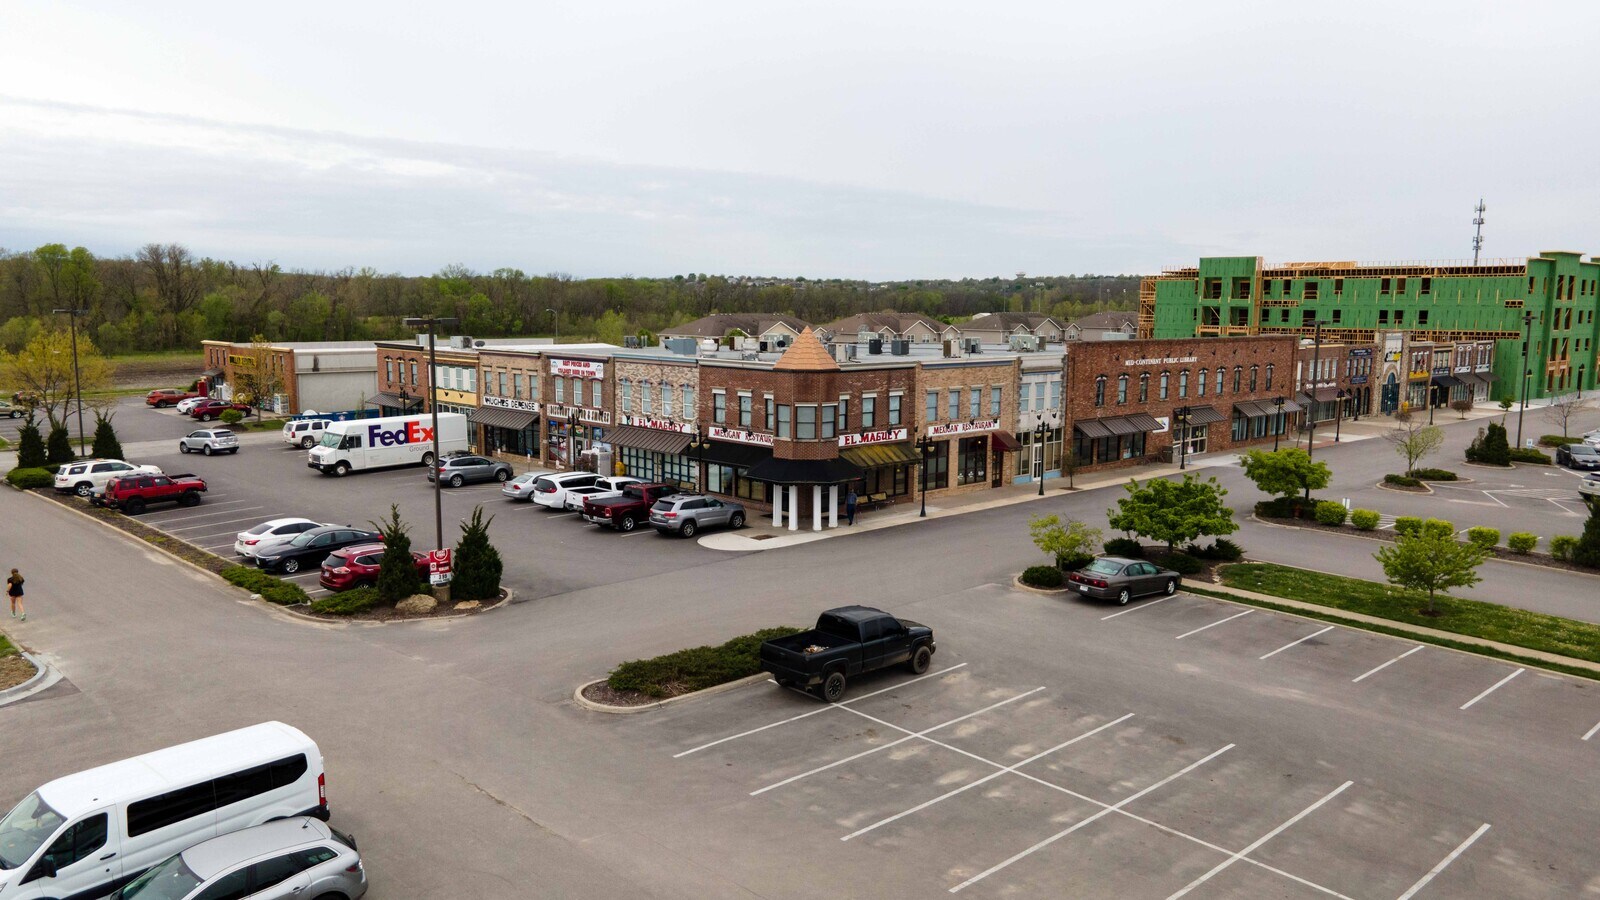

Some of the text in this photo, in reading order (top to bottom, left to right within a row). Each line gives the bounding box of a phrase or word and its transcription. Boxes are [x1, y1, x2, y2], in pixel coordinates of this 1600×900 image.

[1125, 358, 1161, 366] MID-CONTINENT
[511, 400, 535, 410] DEENSE
[368, 421, 434, 447] FedEx
[844, 435, 857, 445] EL
